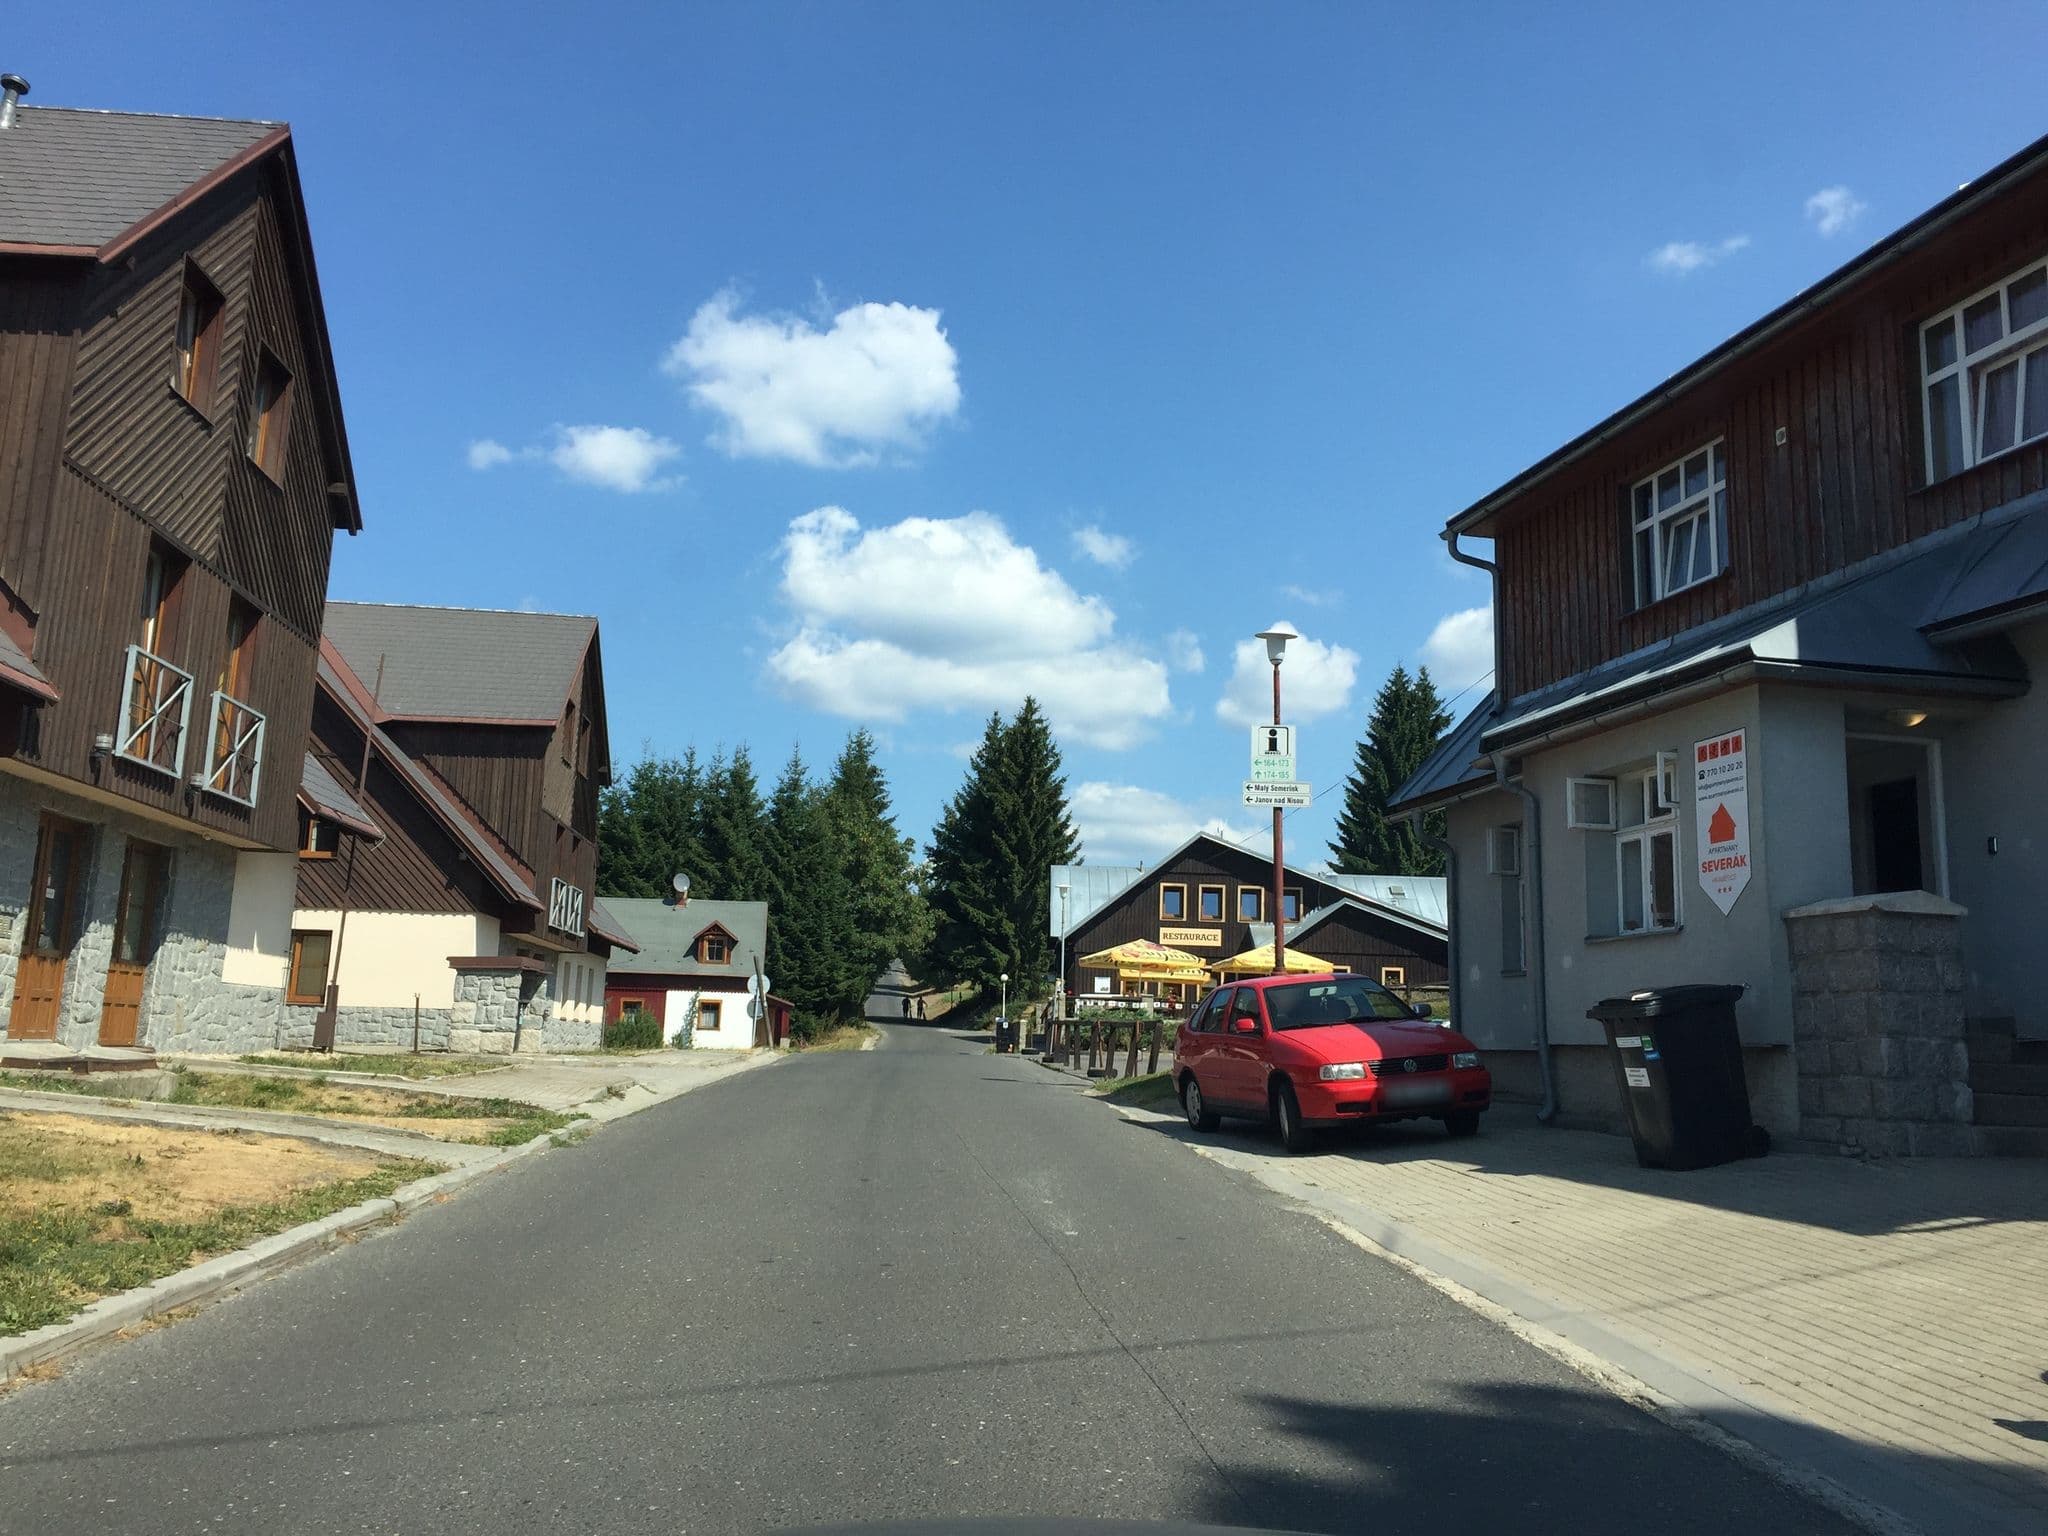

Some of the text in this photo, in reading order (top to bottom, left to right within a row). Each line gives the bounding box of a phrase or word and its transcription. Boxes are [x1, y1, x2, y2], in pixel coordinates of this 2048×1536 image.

[1706, 760, 1743, 777] 770 10 20 20
[1255, 796, 1272, 804] Janov
[1274, 796, 1286, 804] nad
[1701, 852, 1748, 873] SEVERÁK
[1162, 932, 1218, 941] RESTAURACE
